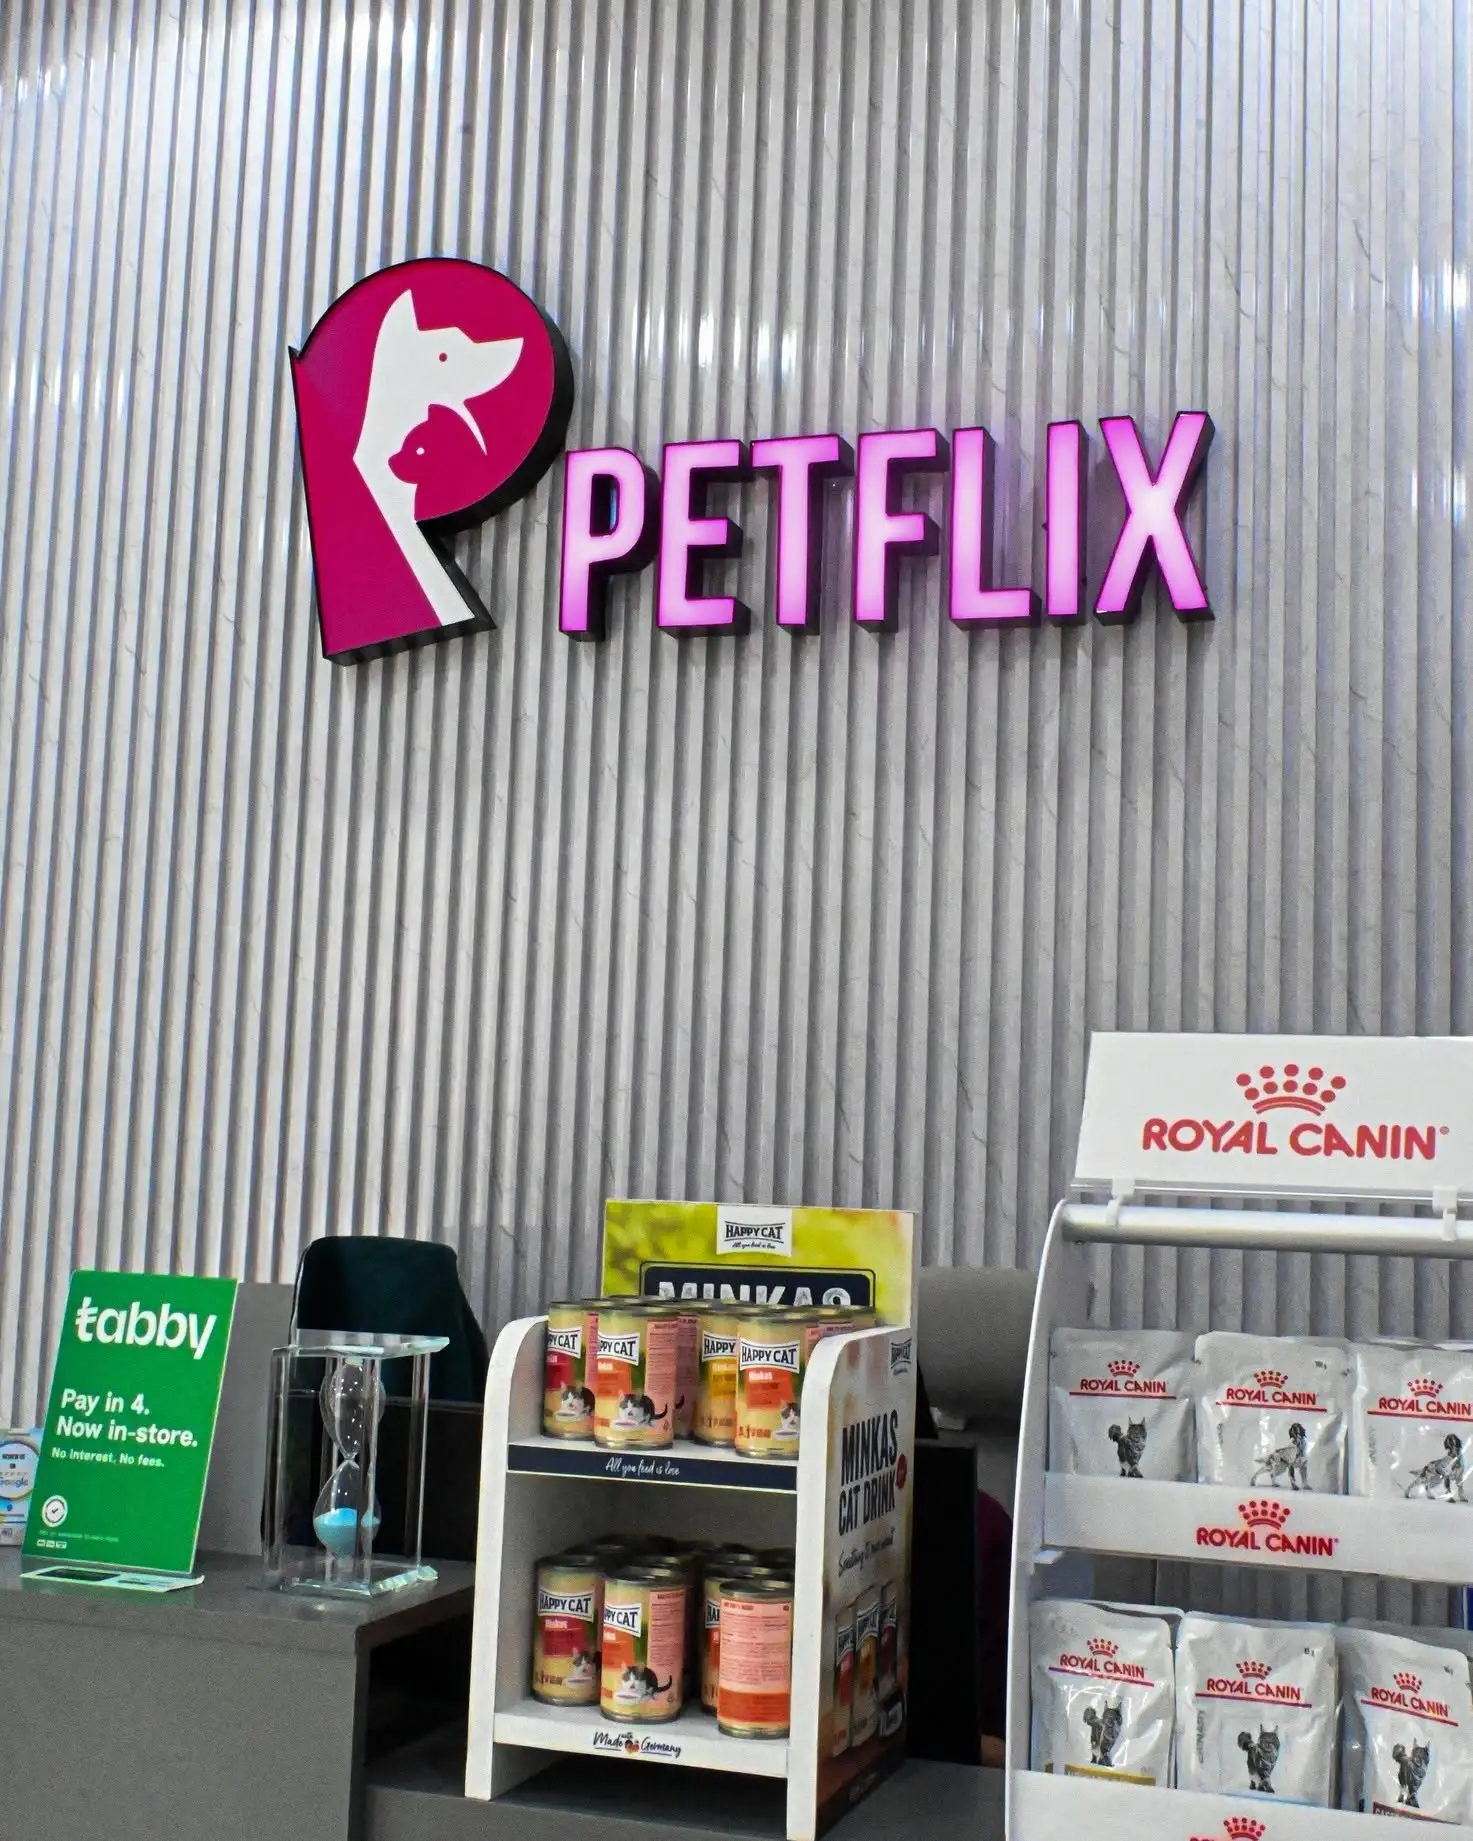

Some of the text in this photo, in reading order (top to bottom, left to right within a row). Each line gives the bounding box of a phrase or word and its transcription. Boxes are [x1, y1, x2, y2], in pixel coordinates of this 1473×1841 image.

[559, 411, 1211, 636] PETFLIX
[1142, 1118, 1437, 1161] ROYAL CANIN
[725, 1224, 784, 1240] HAPPY CAT
[75, 1296, 217, 1360] tabby
[558, 1334, 578, 1350] CAT
[614, 1341, 636, 1357] CAT
[704, 1338, 736, 1354] HAPPY
[741, 1346, 797, 1365] HAPPY CAT
[1080, 1378, 1167, 1394] ROYAL CANIN
[1226, 1387, 1317, 1406] ROYAL CANIN
[61, 1387, 150, 1416] Pay in 4.
[1378, 1397, 1471, 1416] ROYAL CANIN
[56, 1415, 198, 1447] Now in-store.
[52, 1446, 67, 1459] No
[119, 1453, 135, 1464] No
[841, 1408, 899, 1486] MINKAS
[605, 1456, 680, 1479] All you feed is love
[838, 1469, 896, 1537] CAT DRINK
[1196, 1526, 1333, 1557] ROYAL CANIN
[540, 1594, 591, 1615] HAPPY CAT
[616, 1611, 638, 1628] CAT
[1060, 1653, 1144, 1679] ROYAL CANIN
[1207, 1678, 1301, 1701] ROYAL CANIN
[1371, 1687, 1449, 1718] ROYAL CANIN
[593, 1731, 623, 1748] Made
[641, 1736, 682, 1759] Germany
